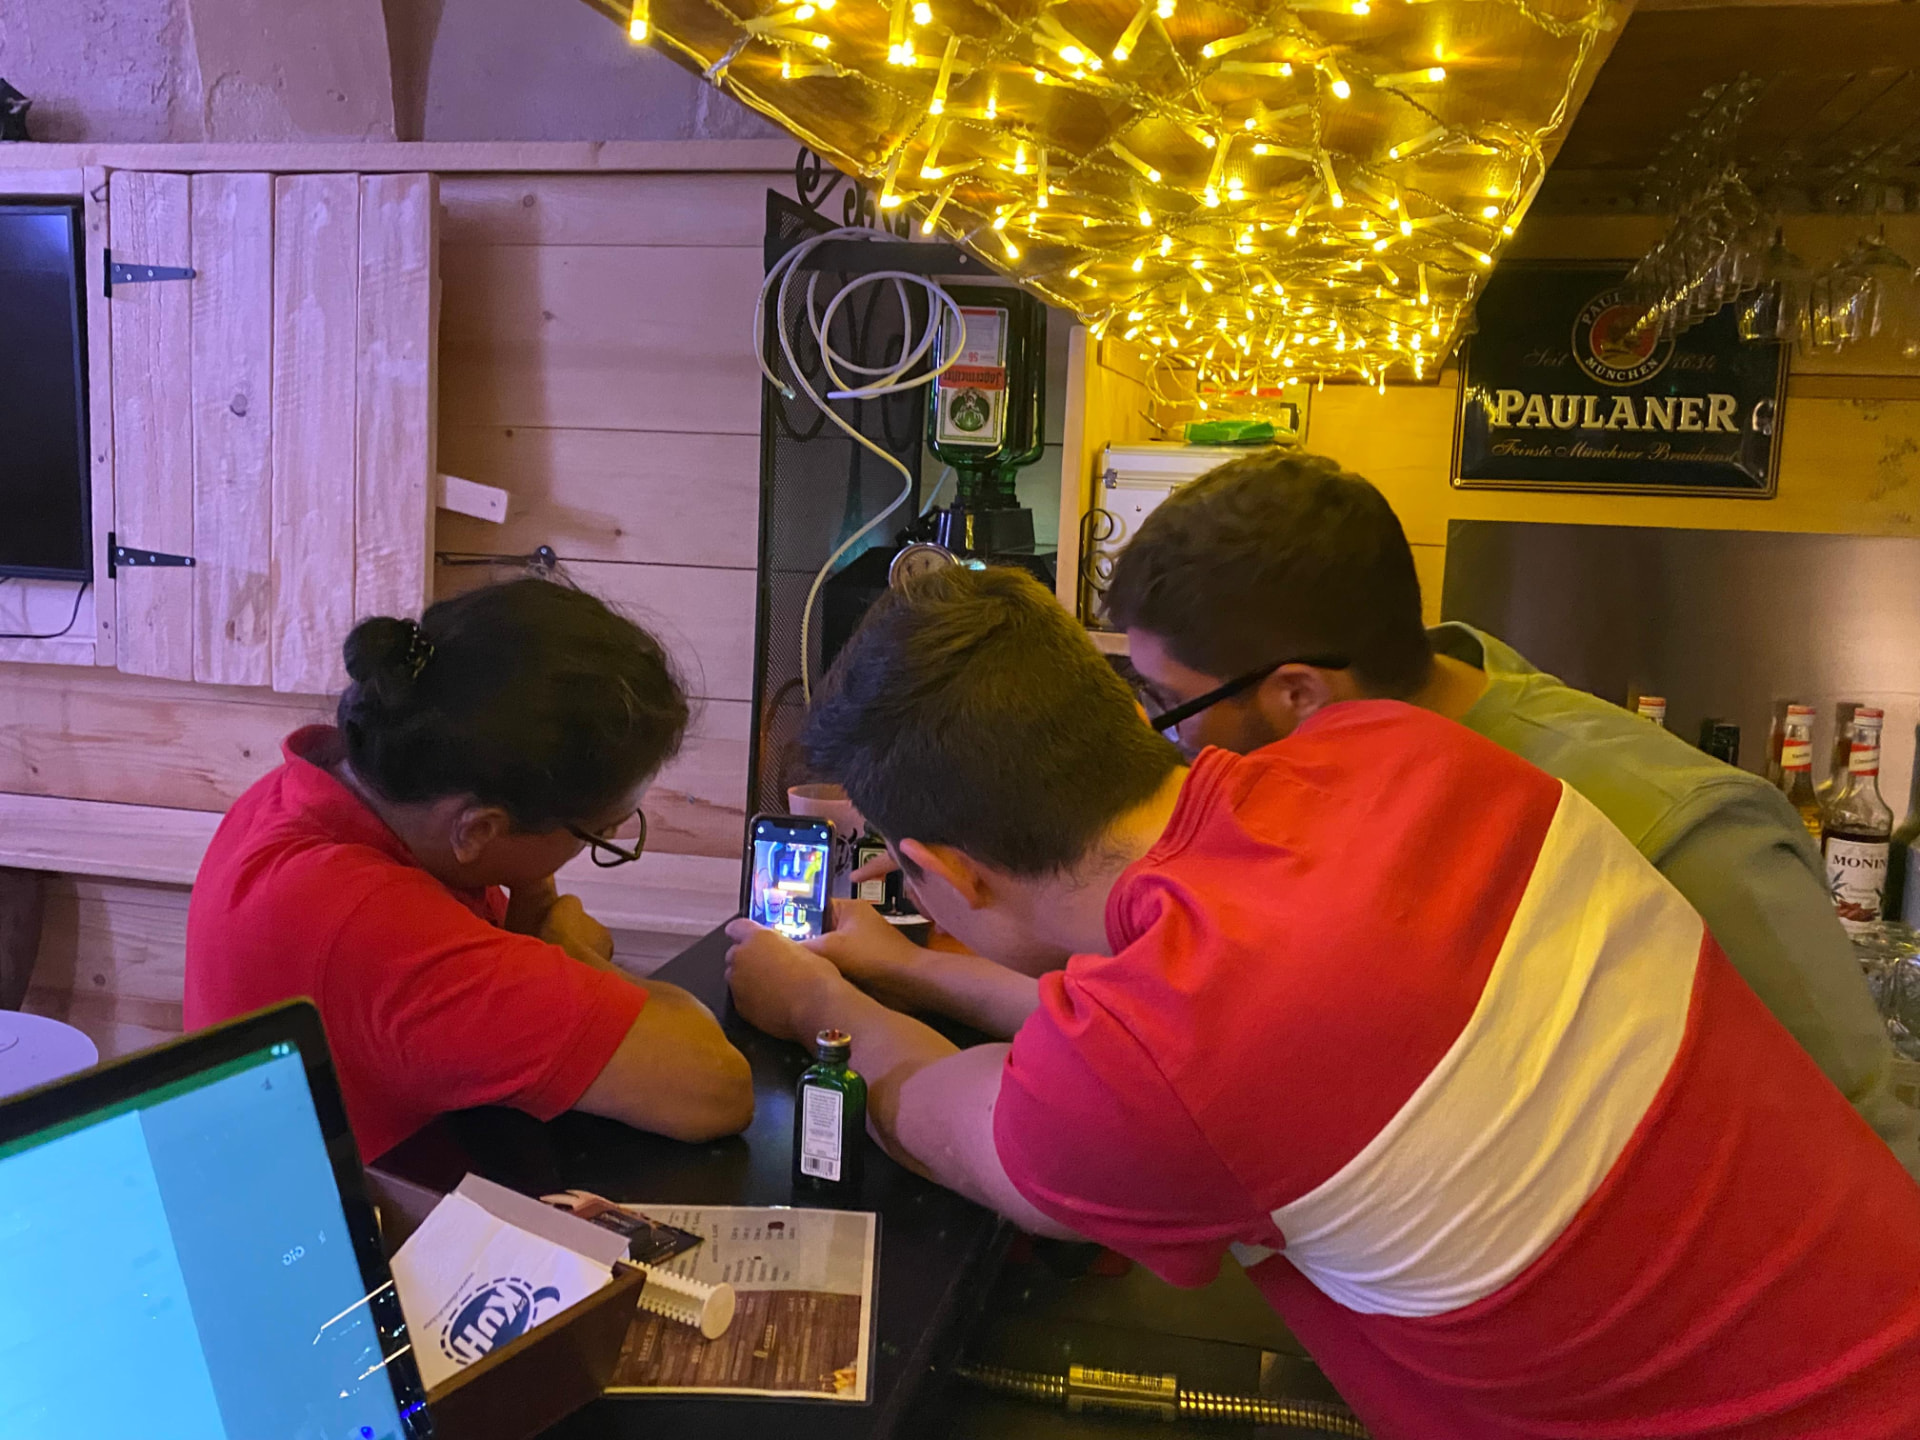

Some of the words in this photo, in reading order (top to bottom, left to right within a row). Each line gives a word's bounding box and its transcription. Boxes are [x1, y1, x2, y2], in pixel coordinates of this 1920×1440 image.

[1495, 389, 1740, 433] PAULANER
[1492, 438, 1551, 457] Feinste
[1832, 854, 1887, 869] MONIN
